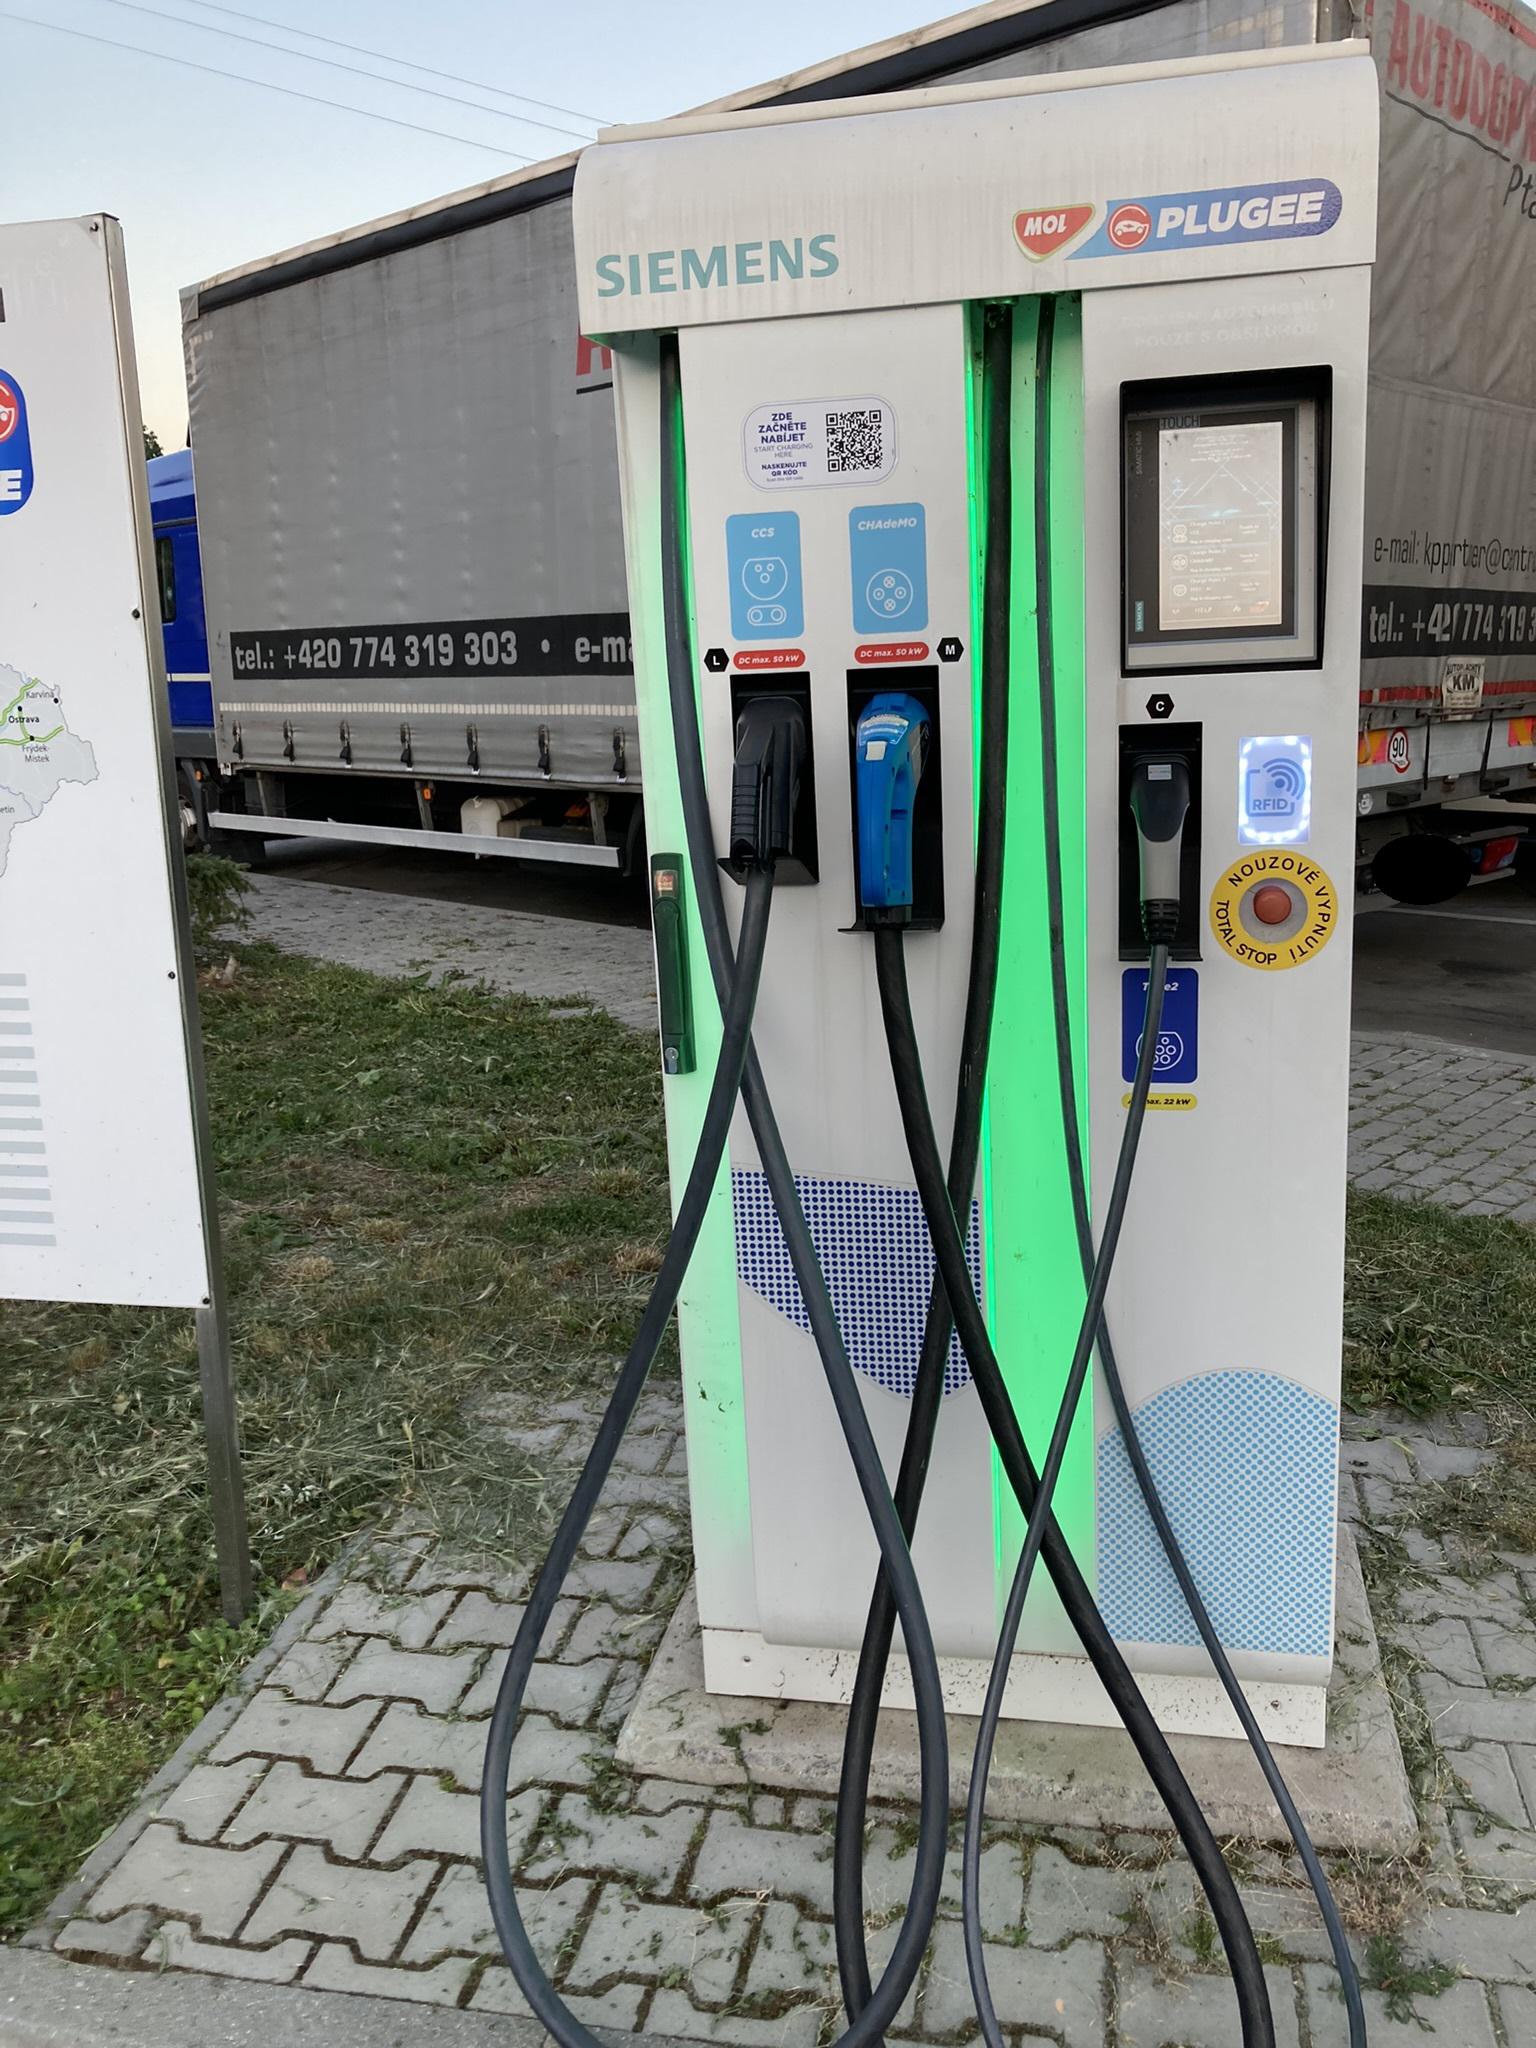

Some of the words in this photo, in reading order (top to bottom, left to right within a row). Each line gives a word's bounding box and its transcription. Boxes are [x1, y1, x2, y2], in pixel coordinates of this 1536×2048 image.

[1156, 190, 1326, 239] PLUGEE
[1024, 213, 1067, 237] MOL
[595, 234, 840, 298] SIEMENS
[771, 412, 793, 421] ZDE
[758, 421, 807, 433] ZAČNĚTE
[761, 432, 805, 444] NABÍJET
[754, 445, 775, 453] START
[761, 461, 807, 470] NASKENUJTE
[857, 517, 917, 531] CHAdeMO
[751, 527, 775, 538] CCS
[1374, 530, 1419, 564] e-mail:
[1369, 601, 1405, 643] tel.:
[1461, 603, 1494, 641] 774
[235, 641, 274, 670] tel.:
[284, 638, 341, 669] +420
[349, 636, 396, 667] 774
[404, 633, 454, 667] 319
[464, 630, 518, 666] 303
[575, 636, 633, 663] e-m
[860, 650, 872, 658] DC
[873, 649, 894, 657] max.
[896, 648, 907, 656] 50
[908, 647, 923, 656] kW
[944, 644, 956, 655] M
[712, 655, 720, 666] L
[738, 657, 751, 665] DC
[752, 656, 771, 664] max.
[772, 655, 784, 663] 50
[785, 654, 800, 663] kW
[1452, 674, 1475, 690] KM
[1155, 700, 1165, 712] C
[8, 715, 40, 723] Ostrava
[1392, 736, 1405, 758] 90
[1252, 798, 1288, 811] RFID
[1228, 856, 1320, 887] NOUZOVÉ
[1289, 886, 1331, 963] VYPNUTÍ
[1215, 900, 1237, 947] TOTAL
[1236, 943, 1277, 965] STOP
[1142, 982, 1179, 991] Te2
